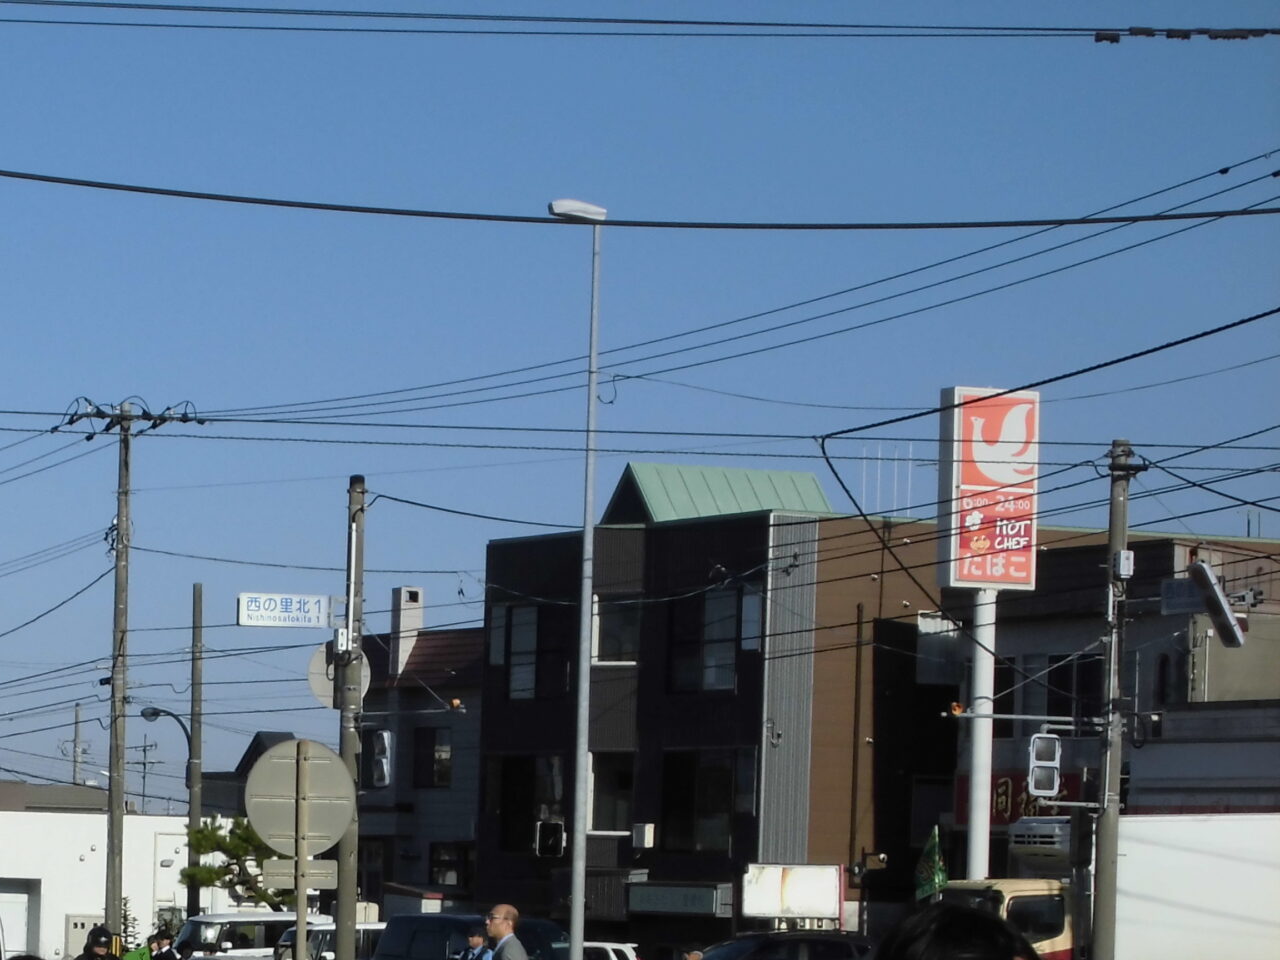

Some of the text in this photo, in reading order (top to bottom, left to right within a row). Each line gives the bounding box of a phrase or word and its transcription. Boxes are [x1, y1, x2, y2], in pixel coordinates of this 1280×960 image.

[996, 518, 1031, 536] HOT
[994, 537, 1029, 550] CHEF
[963, 553, 1027, 577] たばこ
